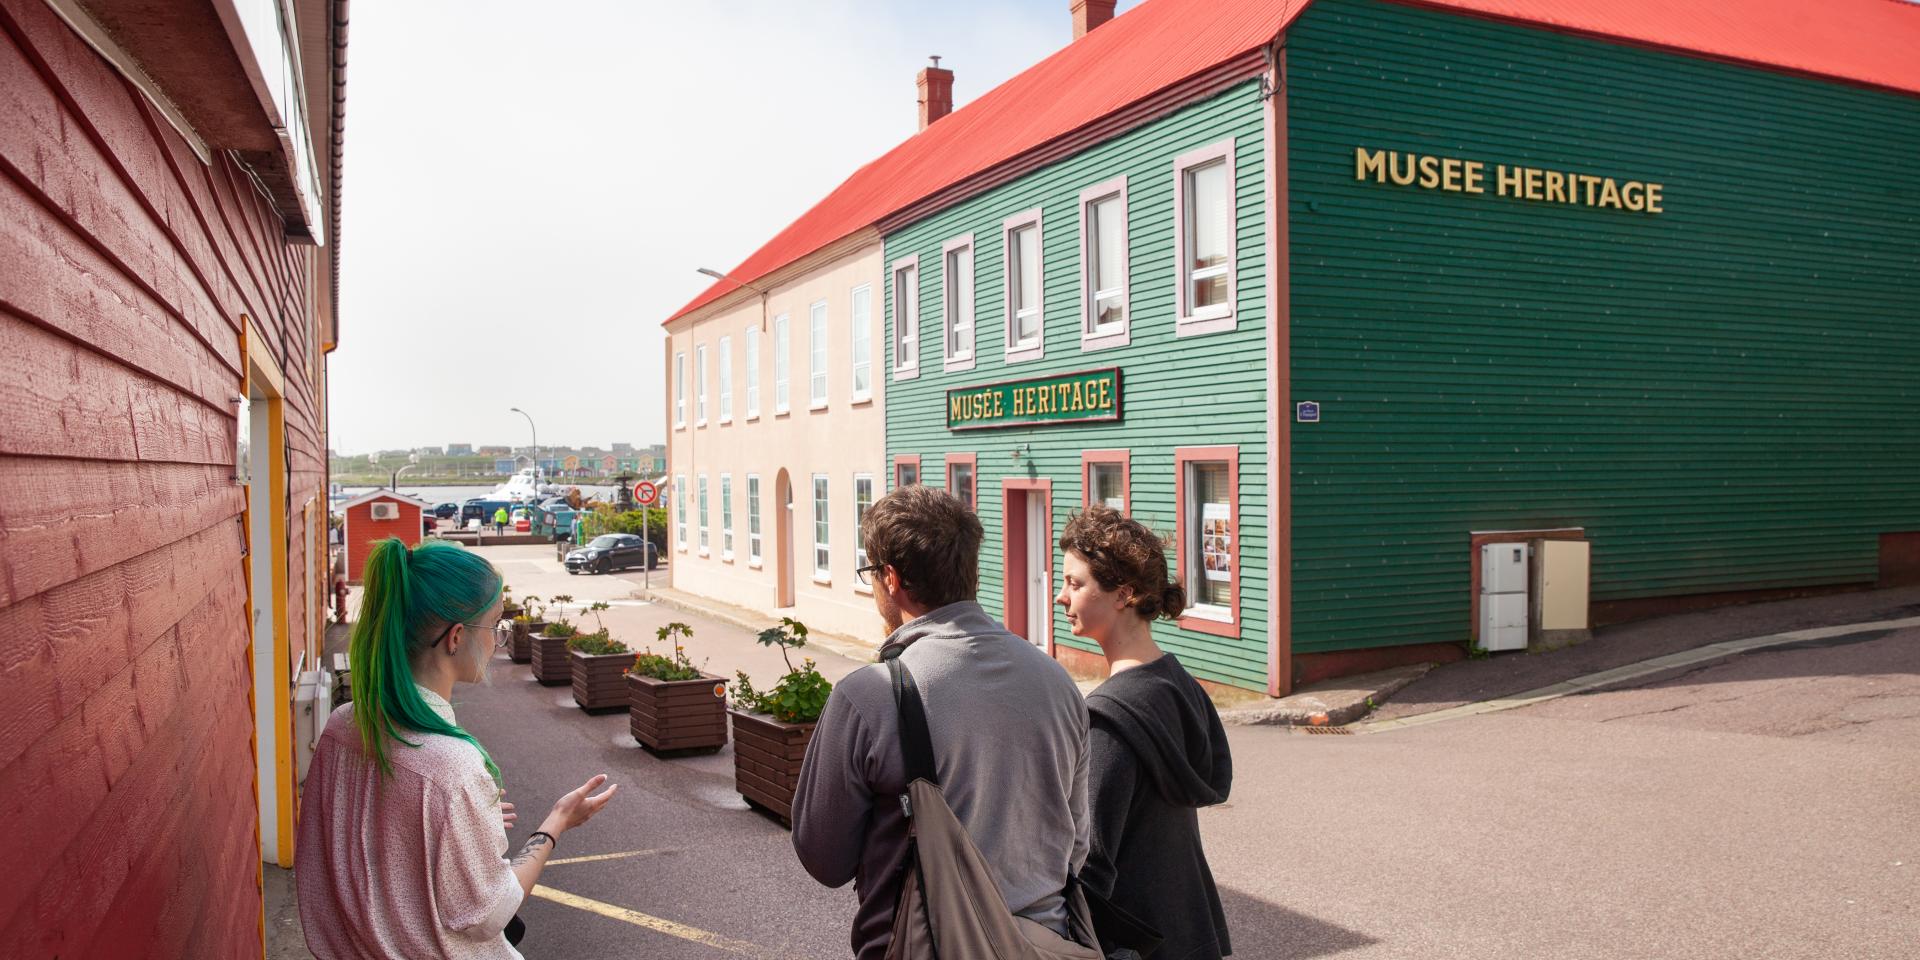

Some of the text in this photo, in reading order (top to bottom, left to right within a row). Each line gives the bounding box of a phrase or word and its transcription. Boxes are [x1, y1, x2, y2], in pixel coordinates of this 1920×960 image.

[1355, 147, 1663, 213] MUSEE HERITAGE
[951, 378, 1112, 421] MUSÉE HERITAGE
